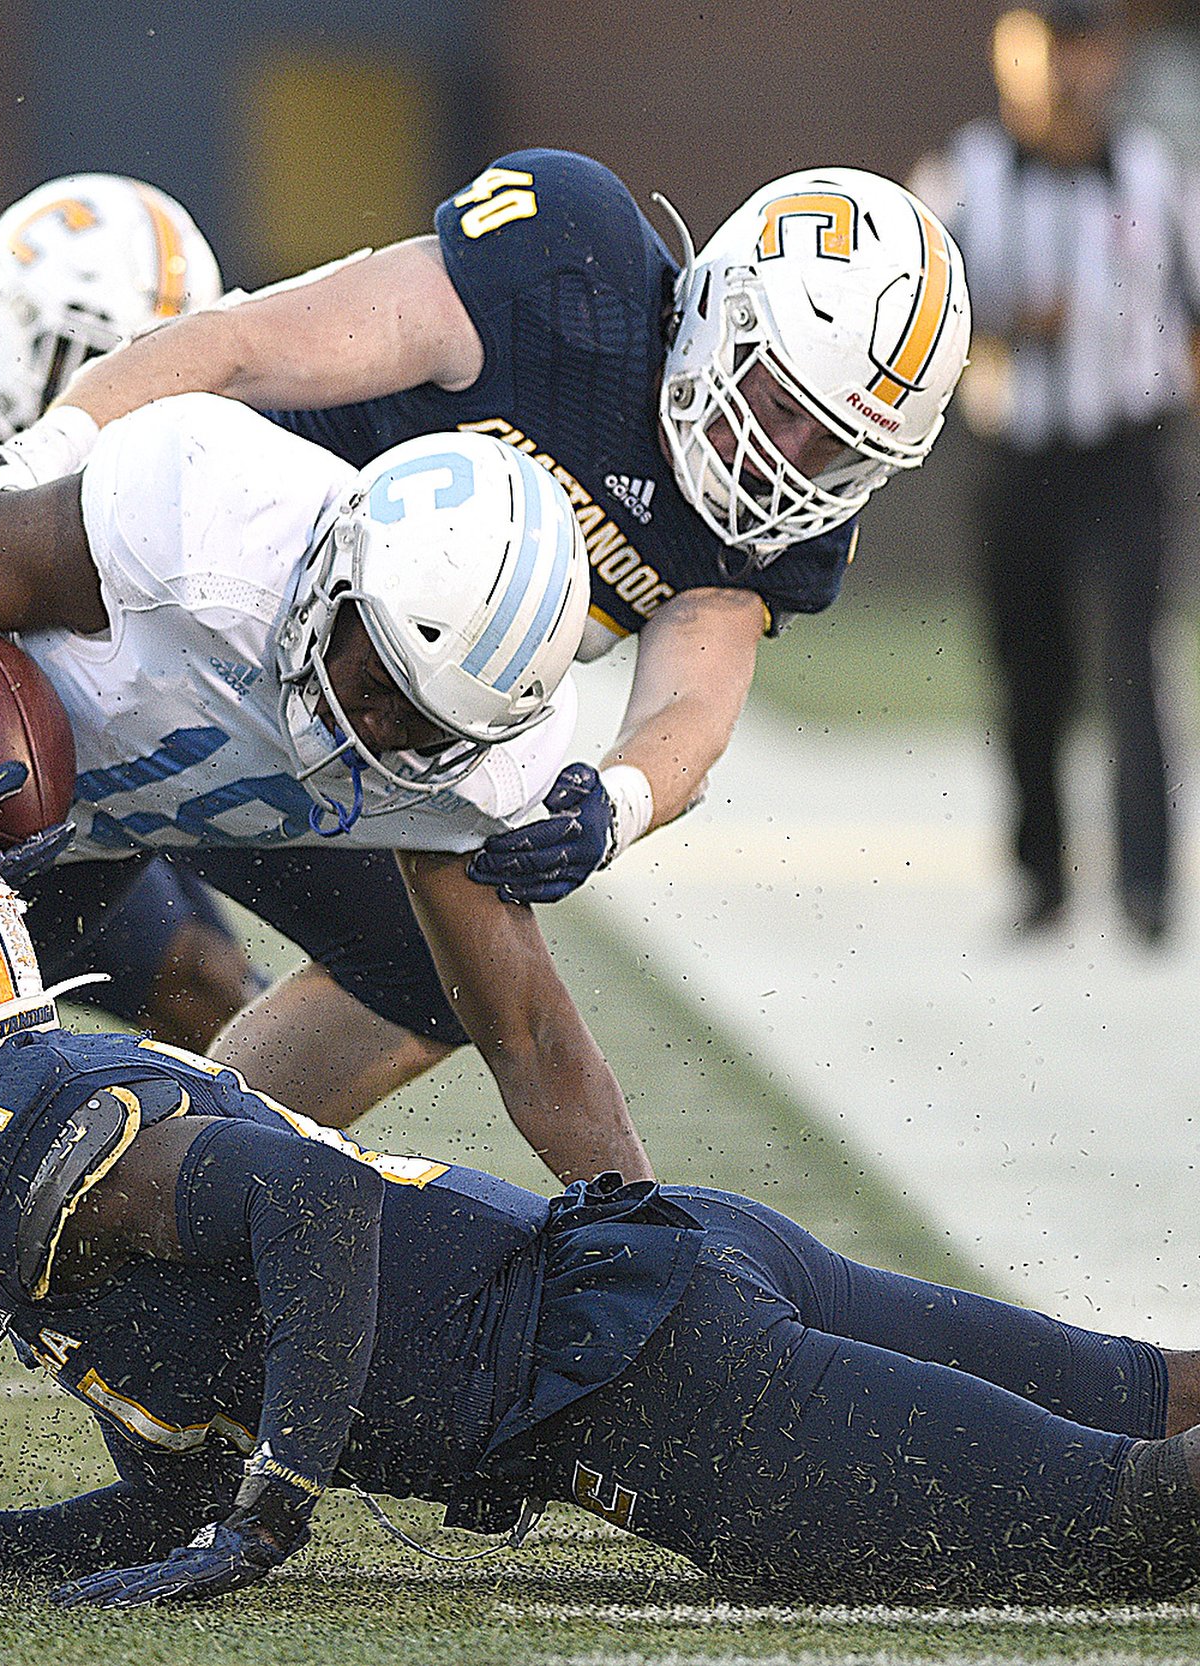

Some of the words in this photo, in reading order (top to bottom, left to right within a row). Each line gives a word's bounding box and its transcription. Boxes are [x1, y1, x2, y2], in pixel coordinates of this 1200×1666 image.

[454, 168, 538, 239] 40
[756, 191, 858, 263] C
[846, 392, 900, 433] Riddell
[369, 452, 474, 525] C
[604, 474, 653, 525] adidas
[209, 656, 250, 696] adidas
